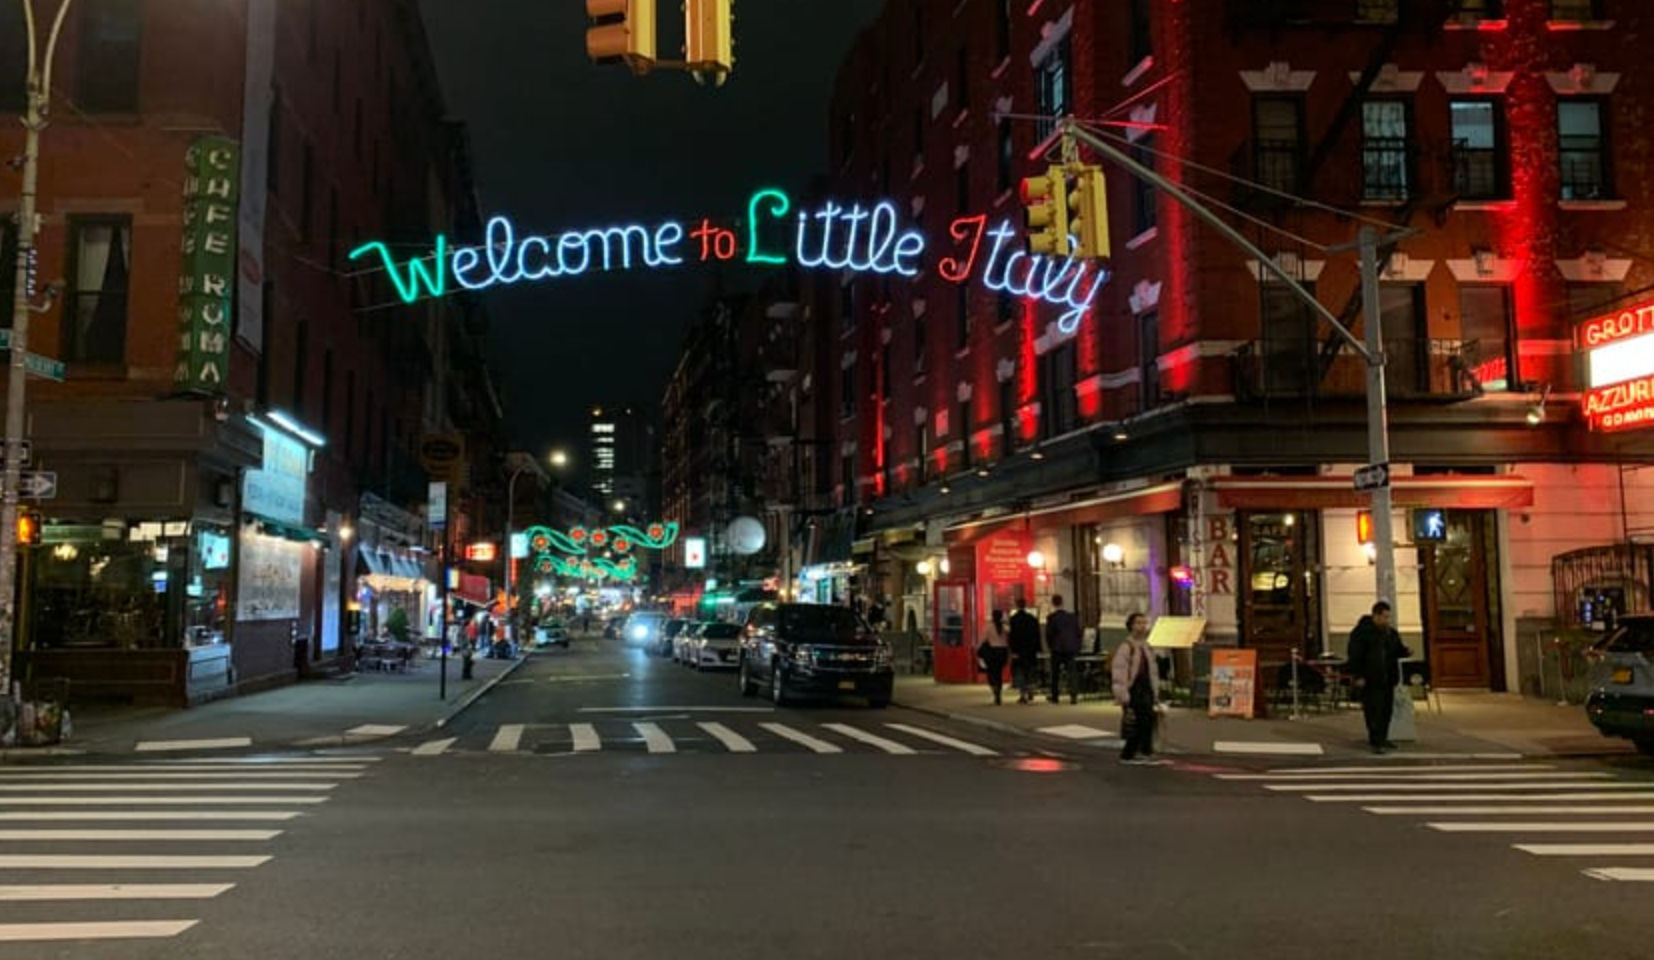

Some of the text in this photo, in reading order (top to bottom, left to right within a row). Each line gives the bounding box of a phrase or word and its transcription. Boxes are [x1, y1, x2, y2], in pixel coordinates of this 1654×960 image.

[348, 188, 1105, 334] Welcome to Little Italy
[200, 273, 226, 384] ROMA
[1583, 380, 1654, 416] AZZUR
[1208, 515, 1231, 595] BAR
